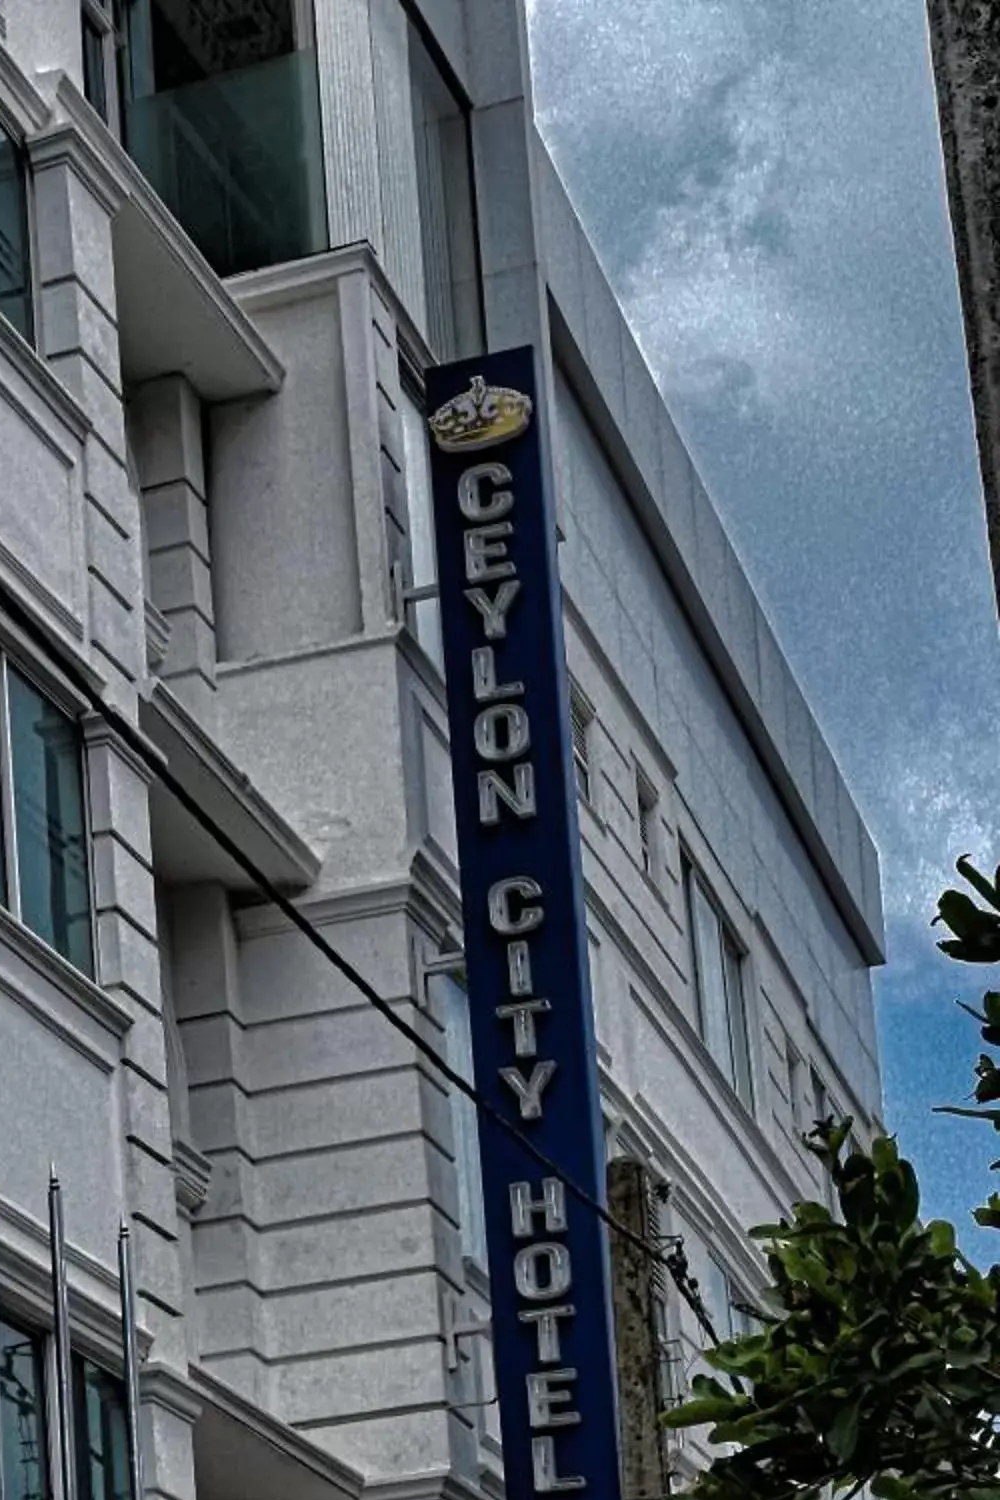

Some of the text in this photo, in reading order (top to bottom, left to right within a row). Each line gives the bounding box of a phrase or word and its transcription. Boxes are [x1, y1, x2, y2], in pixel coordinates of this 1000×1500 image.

[457, 462, 587, 1494] CEYLON CITY HOTEL
